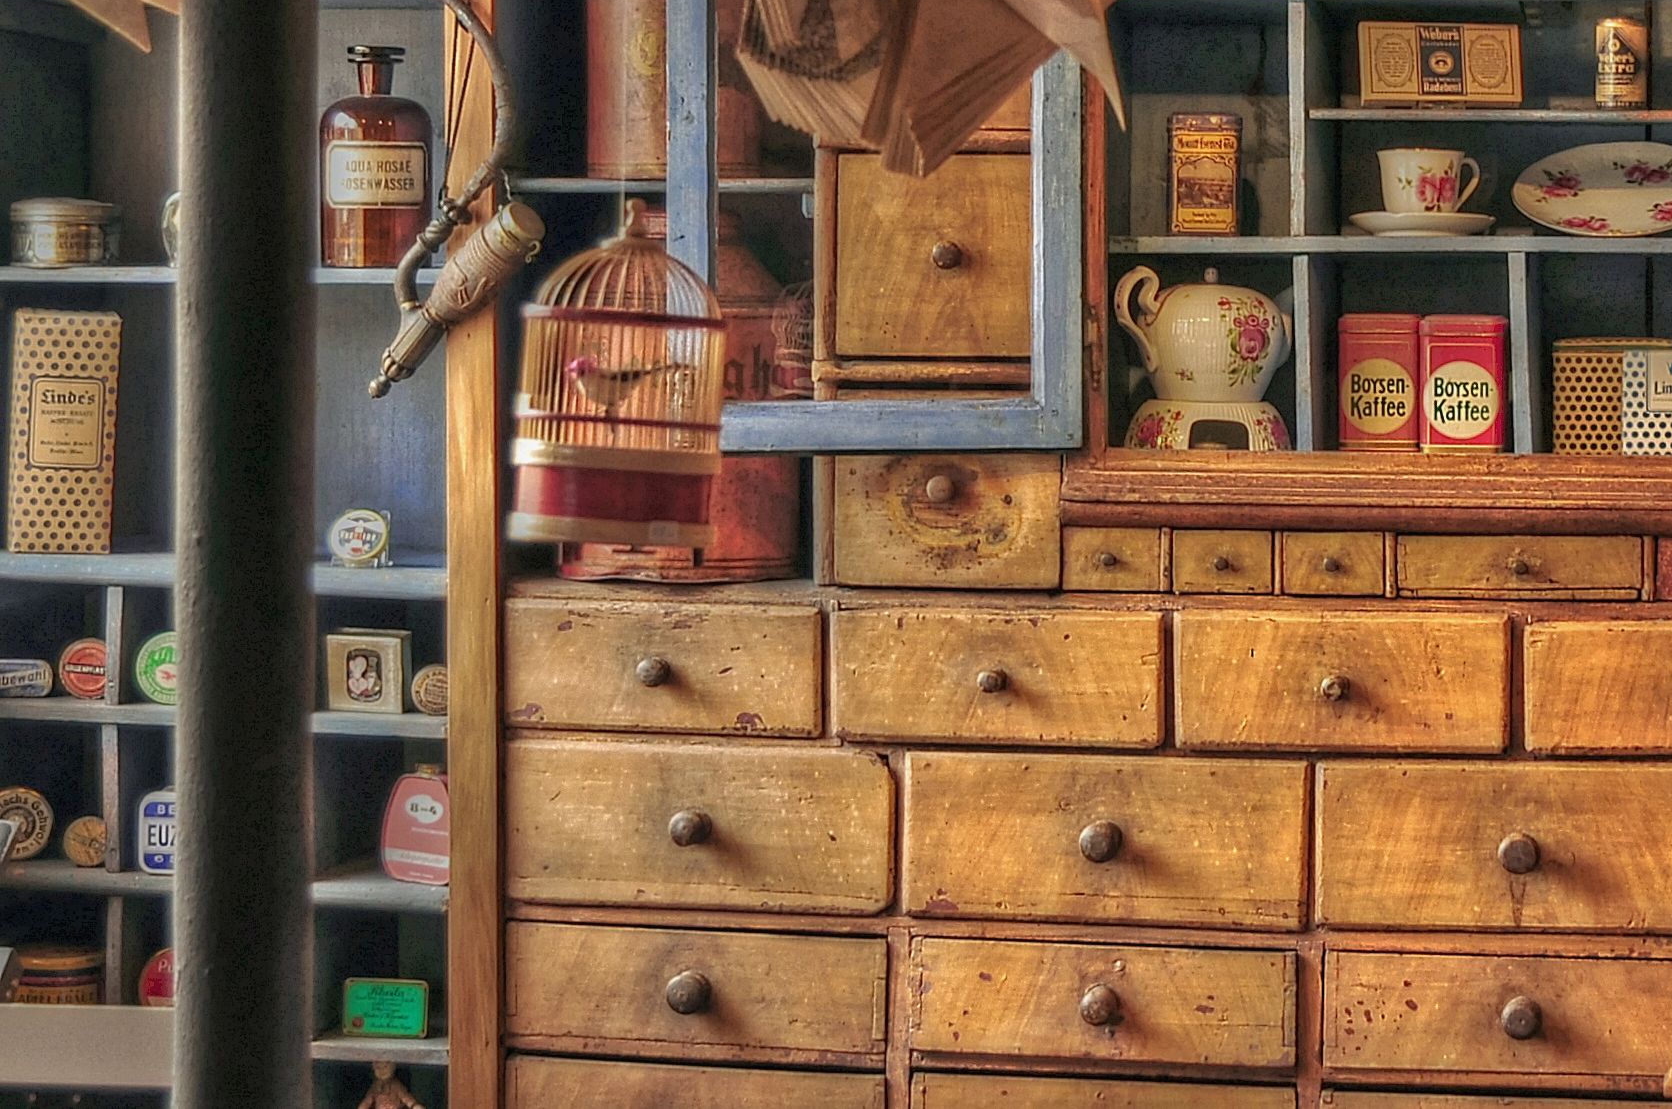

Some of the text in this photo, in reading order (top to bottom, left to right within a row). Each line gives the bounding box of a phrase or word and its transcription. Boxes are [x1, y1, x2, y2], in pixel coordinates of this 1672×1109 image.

[345, 160, 412, 174] AQUA ROSAE
[1350, 394, 1406, 420] Kaffee
[1433, 398, 1490, 424] Kaffee
